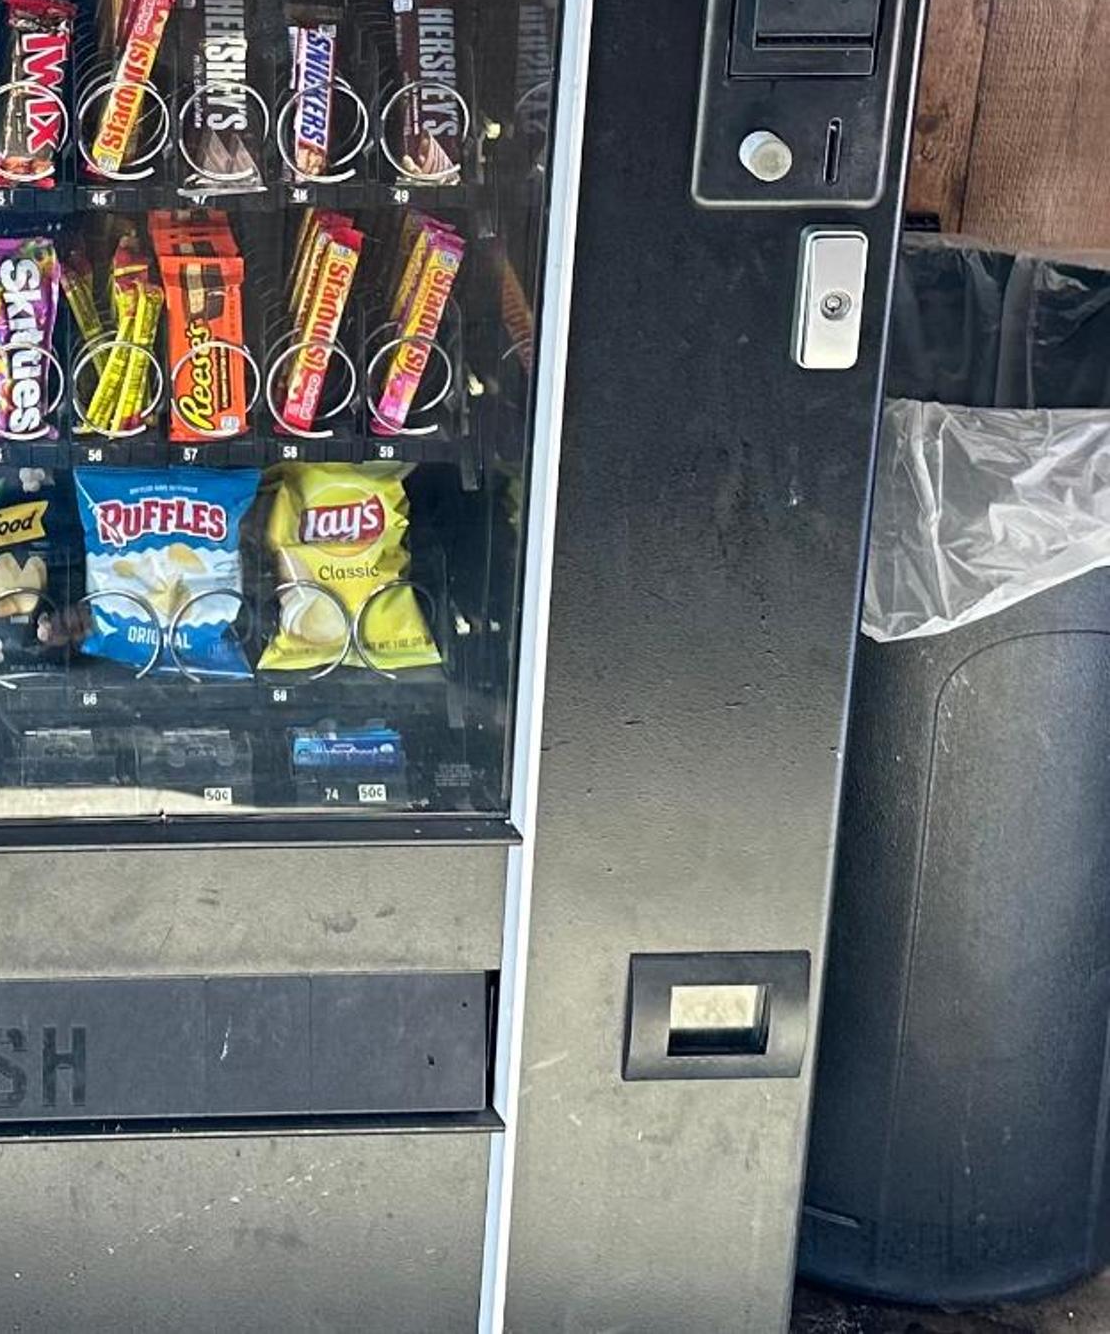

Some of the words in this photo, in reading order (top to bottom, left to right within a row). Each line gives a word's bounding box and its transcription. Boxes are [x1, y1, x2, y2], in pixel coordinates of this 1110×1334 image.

[417, 7, 459, 137] HERSHEY'S
[22, 33, 67, 154] TWIX
[299, 29, 332, 148] SNICKERS
[92, 193, 106, 206] 46
[394, 189, 409, 202] 49
[179, 321, 215, 431] Reese's
[183, 449, 198, 460] 57
[283, 446, 298, 458] 58
[379, 446, 394, 458] 59
[98, 498, 228, 547] RUFFLES
[318, 561, 380, 581] Classic
[127, 624, 191, 650] ORIGNAL
[325, 787, 339, 801] 74
[360, 786, 384, 800] 50¢
